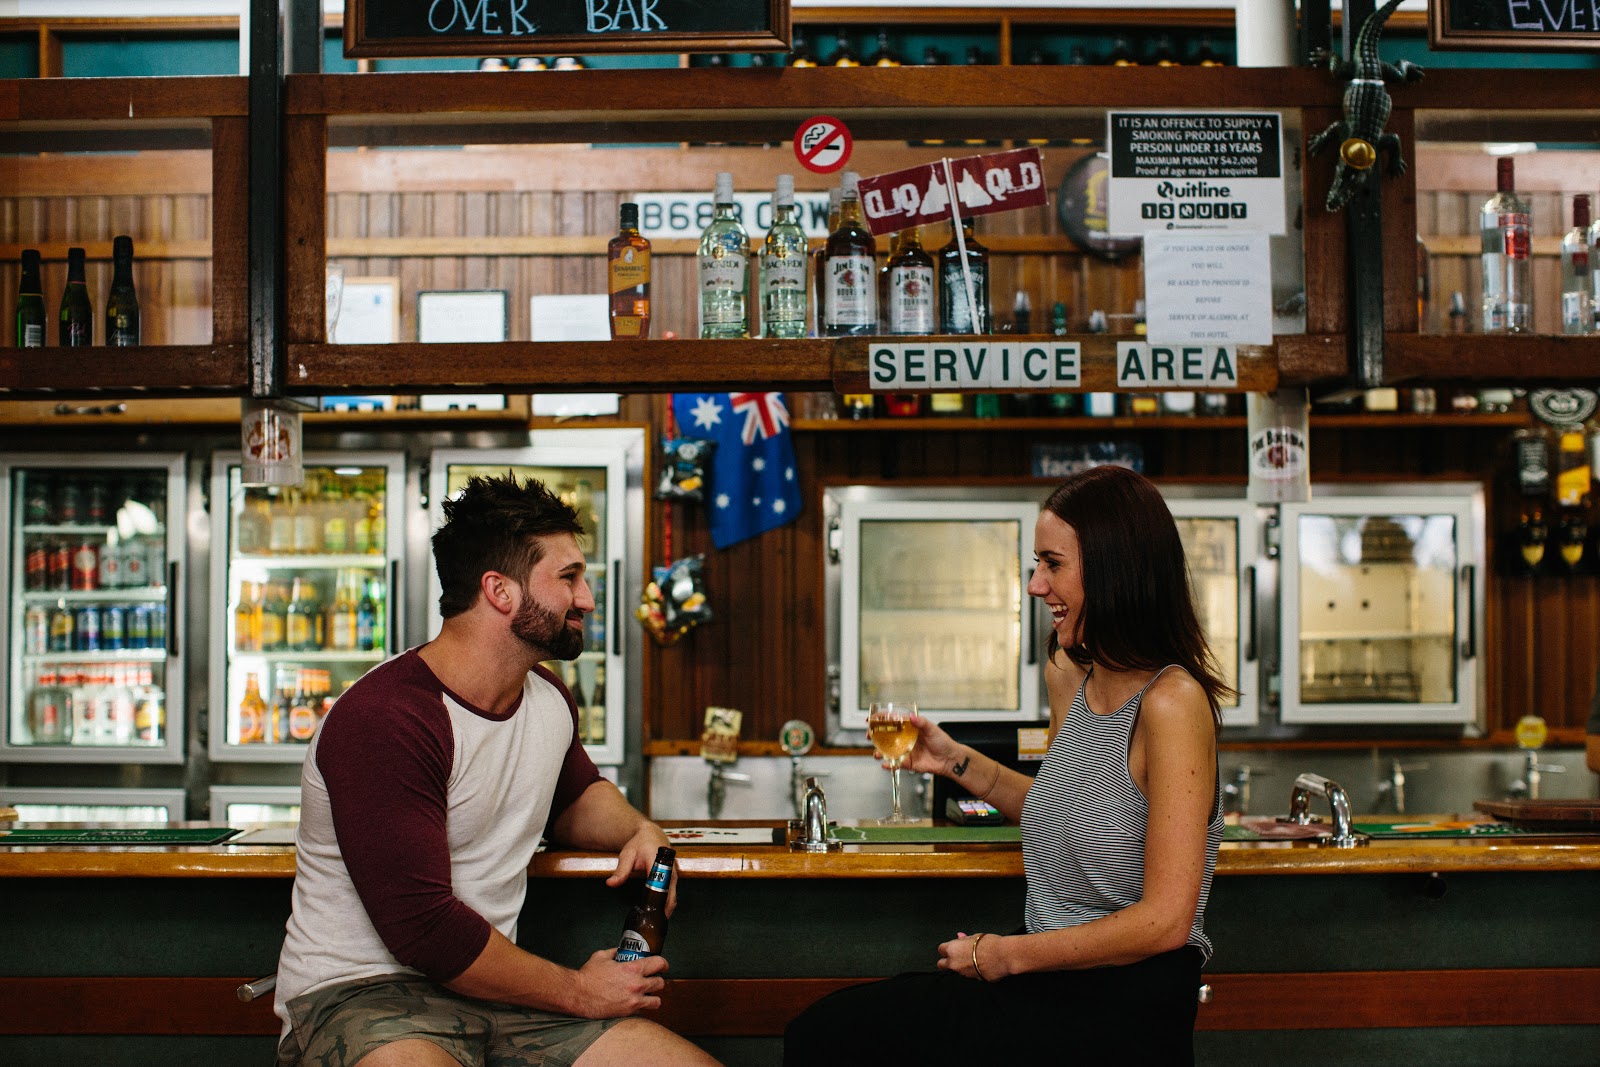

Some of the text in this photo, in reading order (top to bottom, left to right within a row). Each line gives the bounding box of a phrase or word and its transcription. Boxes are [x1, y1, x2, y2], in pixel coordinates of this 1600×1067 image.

[428, 0, 668, 35] OVER BAR
[1119, 118, 1272, 128] IT IS AN OFFENCE TO SUPPLY A
[1132, 130, 1261, 140] SMOKING PRODUCT TO A
[1130, 143, 1263, 153] PERSON UNDER 18 YEARS
[1135, 156, 1258, 165] MAXIMUM PENALTY $42,000
[1135, 166, 1258, 177] Proof of age may be required
[986, 161, 1041, 201] QLD
[1157, 181, 1231, 200] Quitline
[1143, 204, 1245, 218] 13 QUIT
[833, 259, 869, 275] JIM BAM
[837, 288, 866, 296] BOURN
[874, 348, 1076, 383] SERVICE
[1121, 348, 1235, 381] AREA
